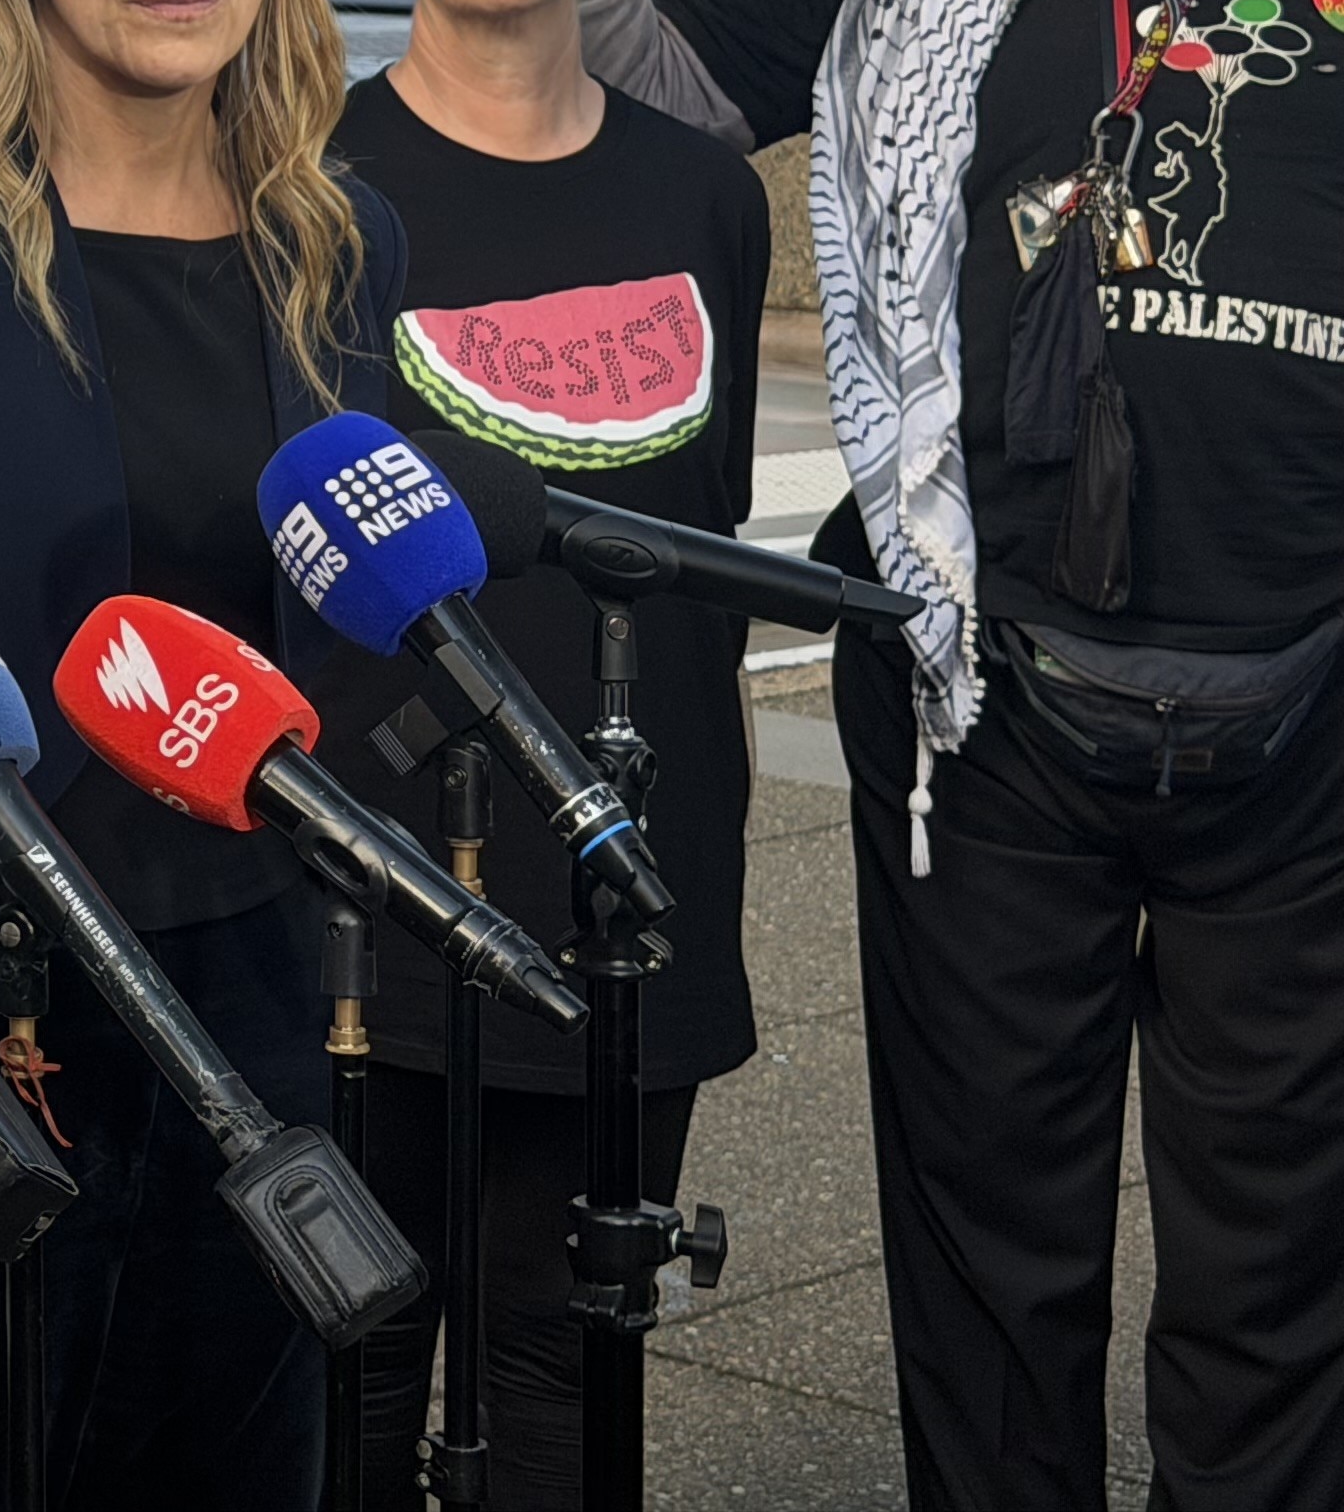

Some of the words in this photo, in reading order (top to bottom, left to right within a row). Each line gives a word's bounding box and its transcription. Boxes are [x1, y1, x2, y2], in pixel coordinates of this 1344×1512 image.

[369, 442, 433, 491] 9
[358, 482, 451, 546] NEWS
[300, 545, 349, 612] NEWS
[158, 673, 240, 769] SBS
[49, 870, 120, 959] SENNHEISER
